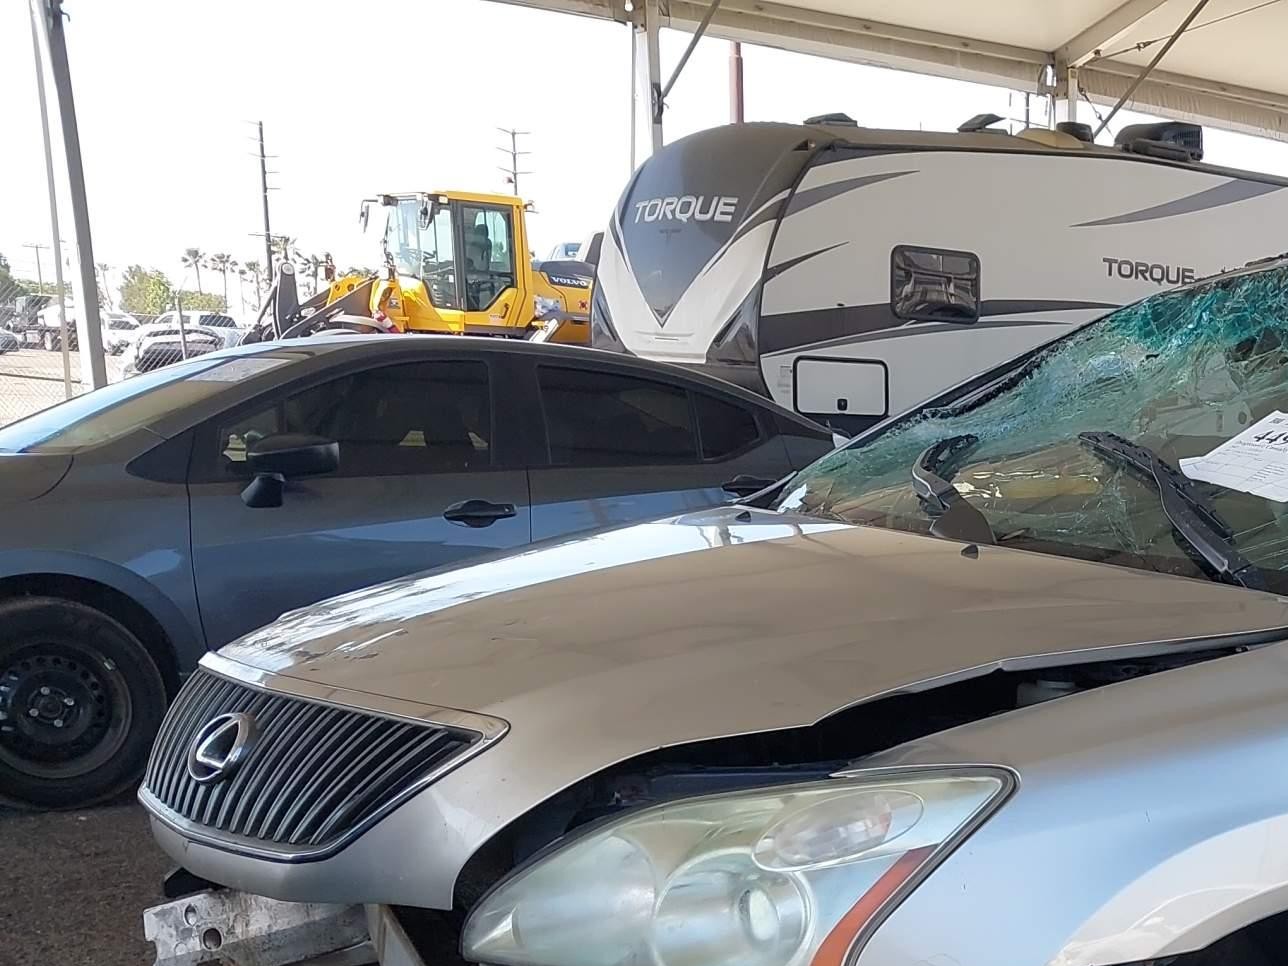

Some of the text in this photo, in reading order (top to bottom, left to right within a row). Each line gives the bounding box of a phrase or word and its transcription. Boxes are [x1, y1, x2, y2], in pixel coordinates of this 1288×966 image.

[634, 195, 739, 224] TORQUE
[550, 276, 588, 287] VOLVO
[1102, 257, 1195, 286] TORQUE
